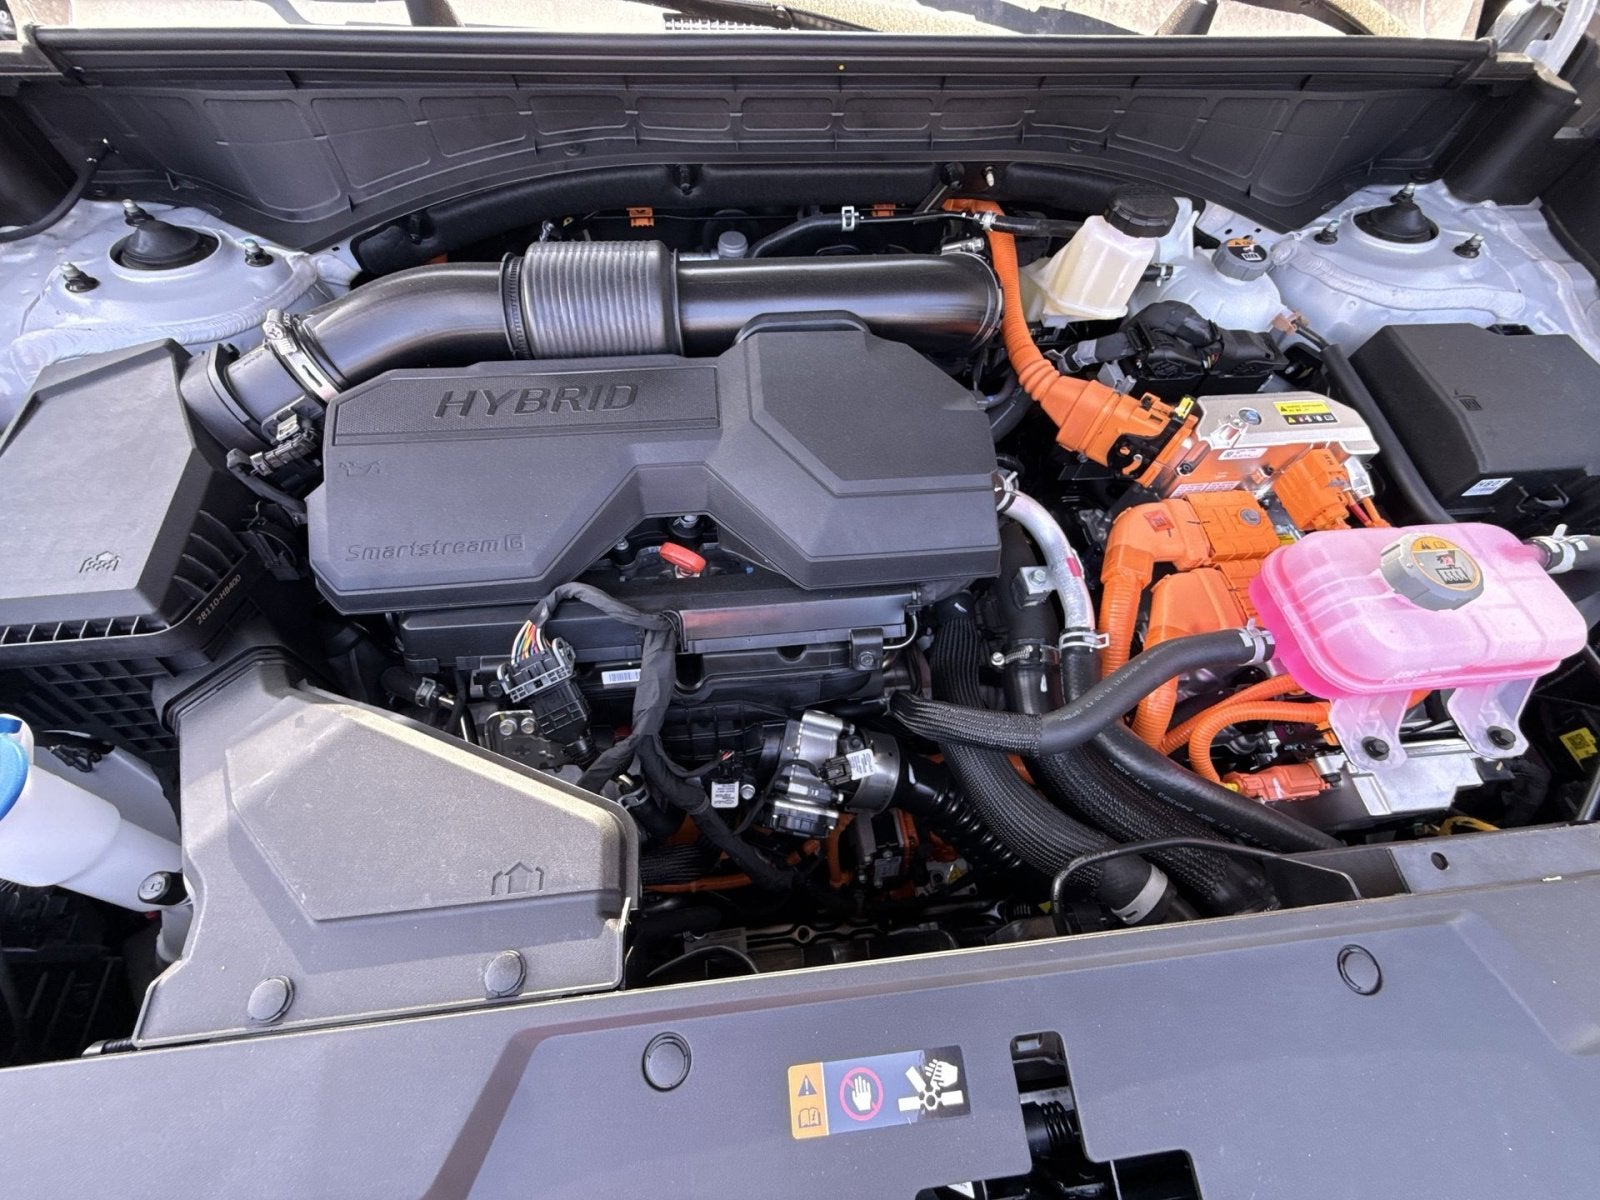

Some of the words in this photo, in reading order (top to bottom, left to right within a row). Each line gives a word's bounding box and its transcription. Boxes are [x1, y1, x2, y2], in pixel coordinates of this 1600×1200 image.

[434, 384, 639, 418] HYBRID
[345, 540, 501, 562] Smartstream
[506, 534, 524, 551] G
